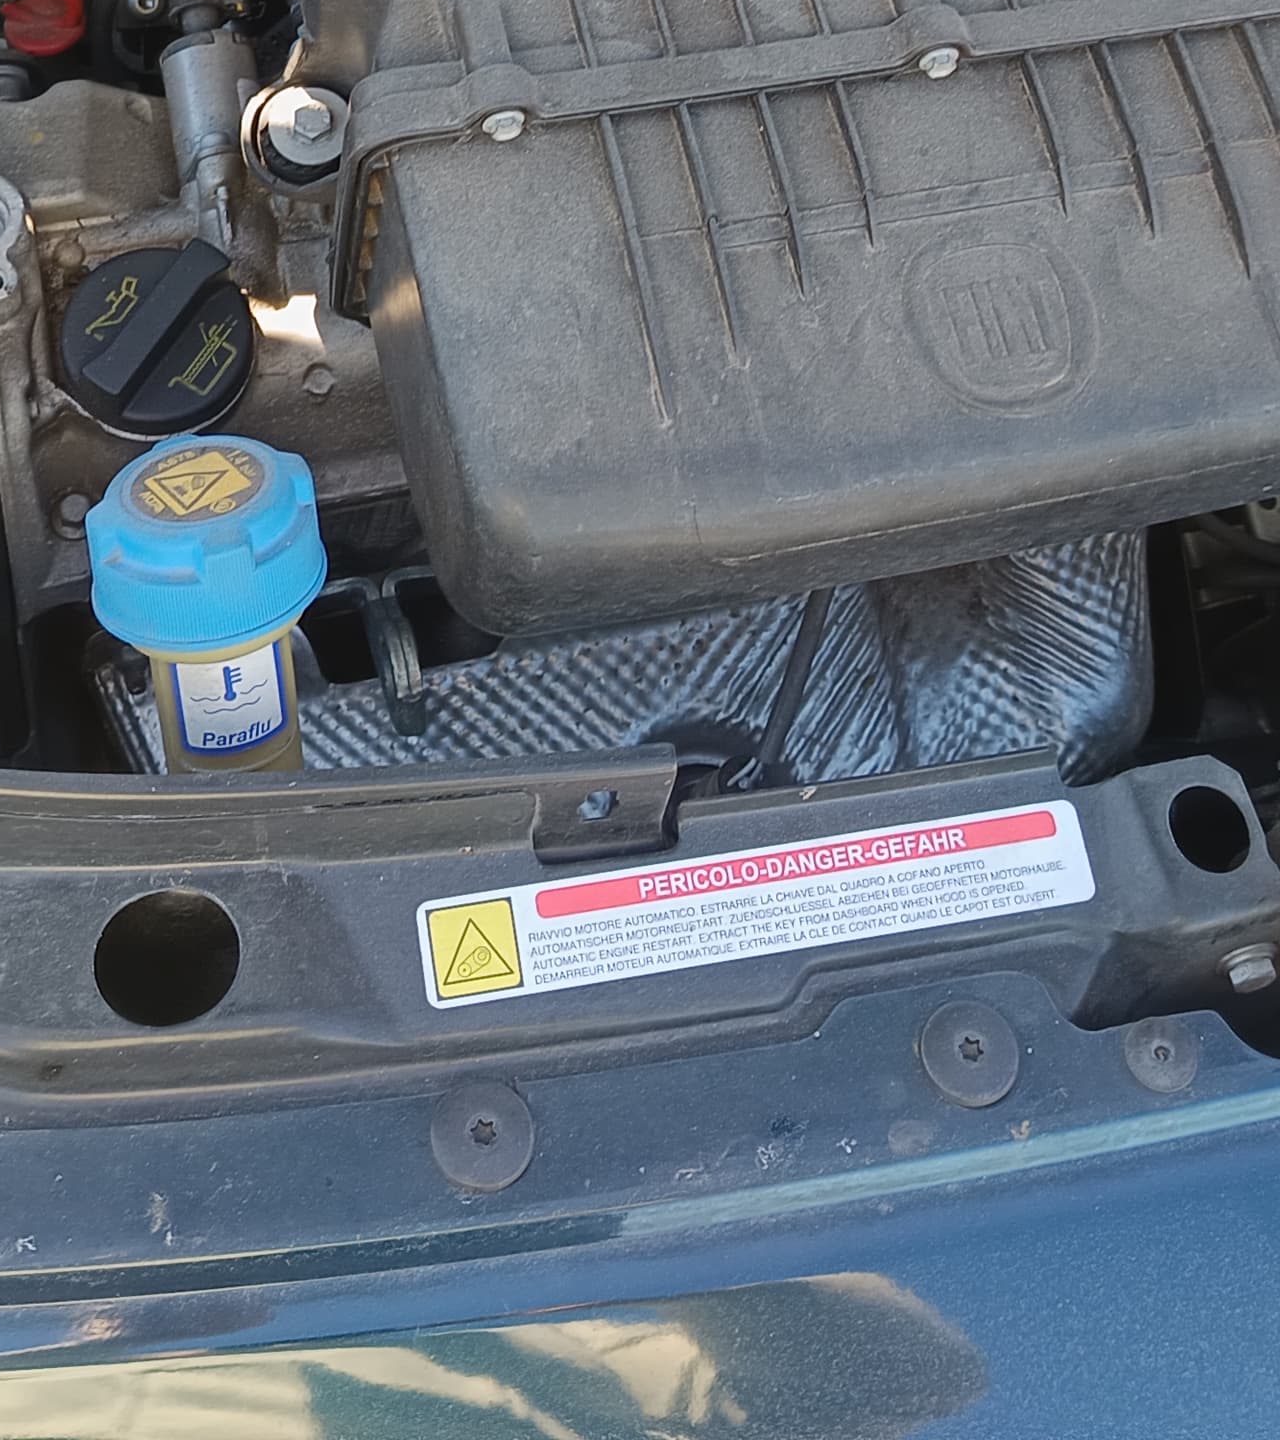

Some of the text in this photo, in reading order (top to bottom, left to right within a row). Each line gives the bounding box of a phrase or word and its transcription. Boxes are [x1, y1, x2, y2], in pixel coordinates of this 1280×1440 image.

[202, 718, 271, 748] Paraflu
[638, 829, 967, 900] PERICOLO-DANGER-GEFAHR
[528, 926, 572, 943] RIAVVIO
[575, 918, 622, 935] MOTORE
[700, 897, 757, 915] ESTRARRE
[760, 894, 773, 905] LA
[775, 887, 815, 903] CHIAVE
[817, 884, 837, 896] DAL
[840, 876, 885, 892] QUADRO
[887, 874, 896, 885] A
[897, 867, 941, 883] COFANO
[529, 933, 624, 957] AUTOMATISCHER
[729, 898, 835, 924] ZUENDSCHLUESSEL
[838, 889, 890, 906] ABZIEHEN
[892, 886, 910, 897] BEI
[911, 873, 988, 894] GEOEFFNETER
[532, 951, 596, 971] AUTOMATIC
[599, 944, 640, 960] ENGINE
[698, 926, 748, 943] EXTRACT
[752, 922, 772, 935] THE
[775, 918, 797, 931] KEY
[798, 913, 830, 927] FROM
[832, 902, 898, 921] DASHBOARD
[901, 896, 933, 910] WHEN
[935, 890, 967, 904] HOOD
[969, 888, 979, 899] IS
[534, 964, 605, 985] DEMARREUR
[607, 956, 654, 973] MOTEUR
[739, 933, 791, 951] EXTRAIRE
[793, 931, 806, 942] LA
[808, 927, 829, 939] CLE
[832, 924, 846, 936] DE
[848, 915, 899, 933] CONTACT
[901, 909, 938, 924] QUAND
[940, 907, 952, 918] LE
[954, 900, 989, 915] CAPOT
[992, 897, 1012, 909] EST
